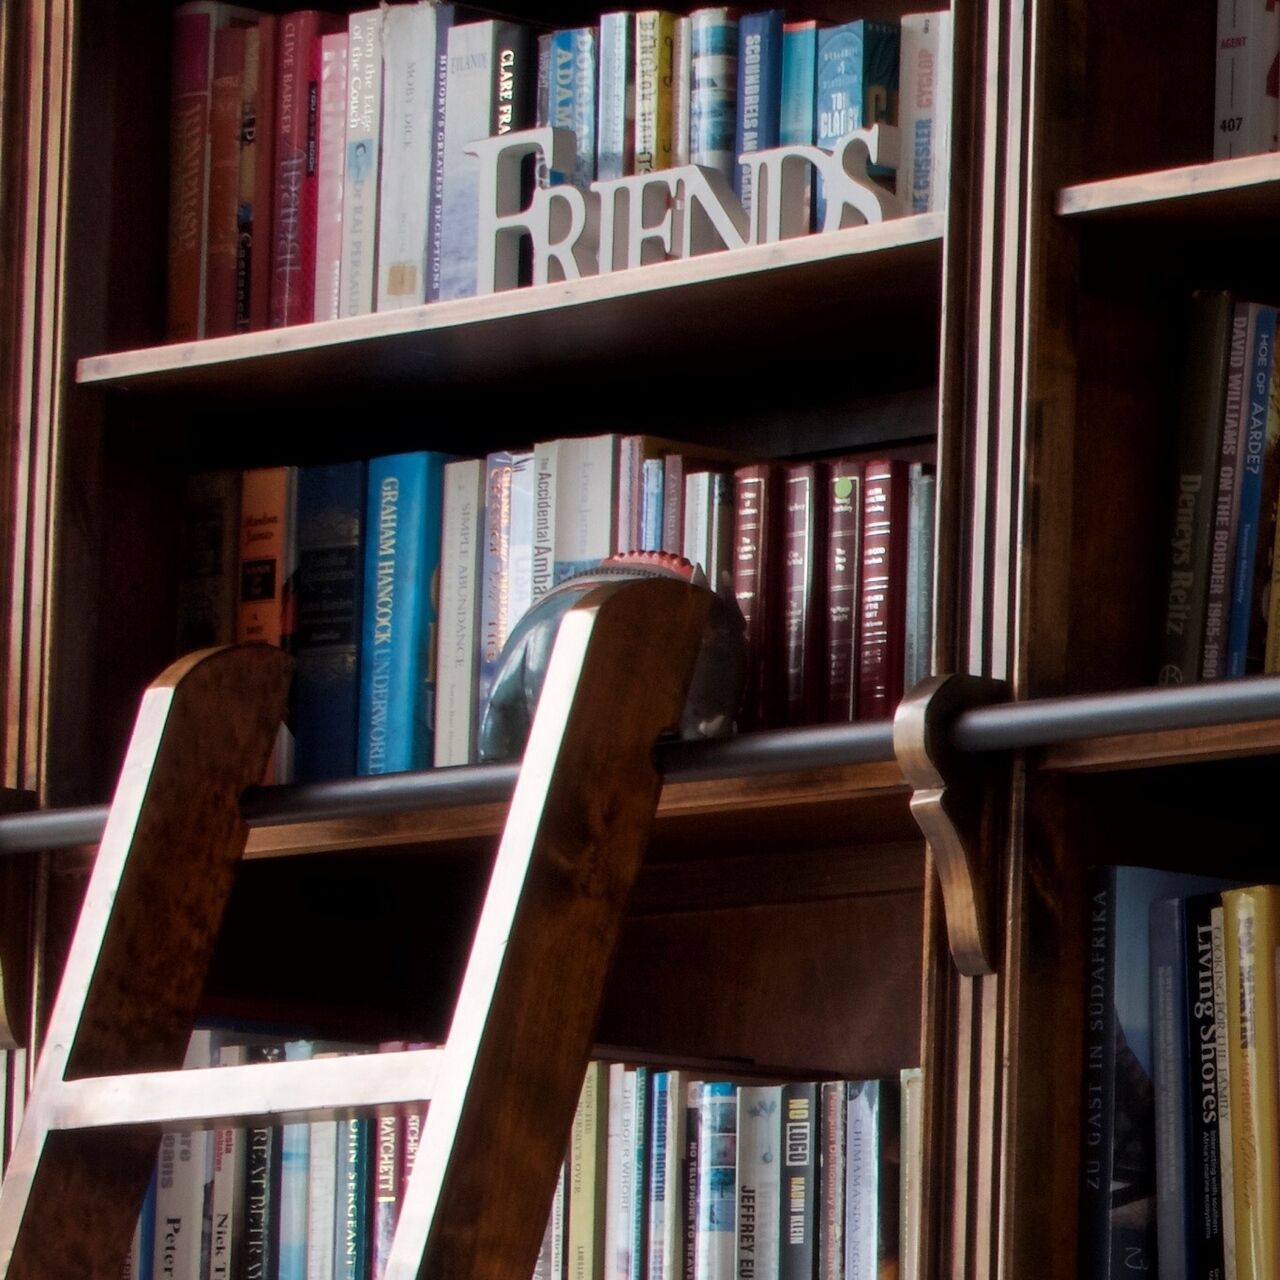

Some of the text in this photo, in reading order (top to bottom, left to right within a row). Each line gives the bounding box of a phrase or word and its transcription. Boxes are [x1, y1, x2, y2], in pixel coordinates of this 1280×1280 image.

[500, 50, 514, 101] CLARE
[432, 205, 443, 289] DECEPTIONS
[464, 124, 885, 296] FRIENDS
[535, 473, 552, 543] Accidental
[1202, 317, 1247, 678] DAVID WILLIAMS ON THE BORDER 1965-1990
[375, 476, 398, 645] GRAHAM HANCOCK
[1194, 922, 1221, 1123] Living Shores
[740, 1185, 755, 1253] JEFFREY
[788, 1099, 809, 1243] NO LOGO NAOMI KLEIN
[851, 1119, 863, 1232] CHIMAMANDA
[164, 1217, 182, 1277] Peter
[216, 1213, 229, 1257] Nick
